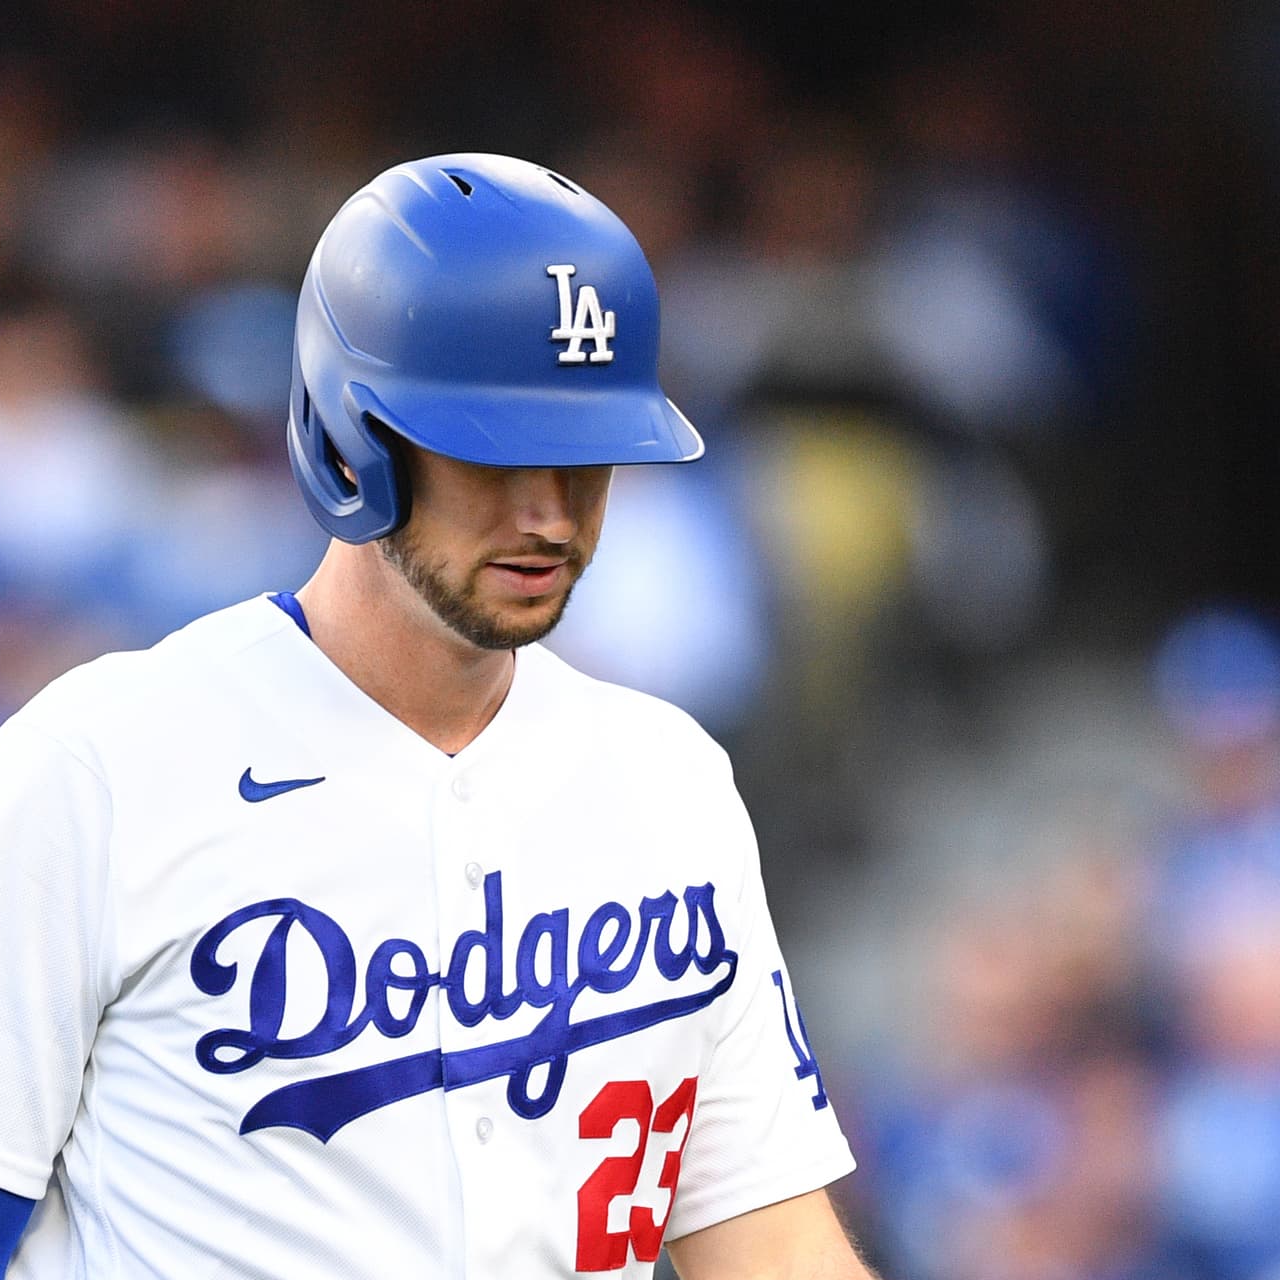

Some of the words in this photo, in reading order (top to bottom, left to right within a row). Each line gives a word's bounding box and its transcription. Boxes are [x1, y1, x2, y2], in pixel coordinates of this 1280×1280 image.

[546, 264, 616, 362] LA
[190, 869, 738, 1121] Dodgers
[576, 1076, 698, 1271] 23
